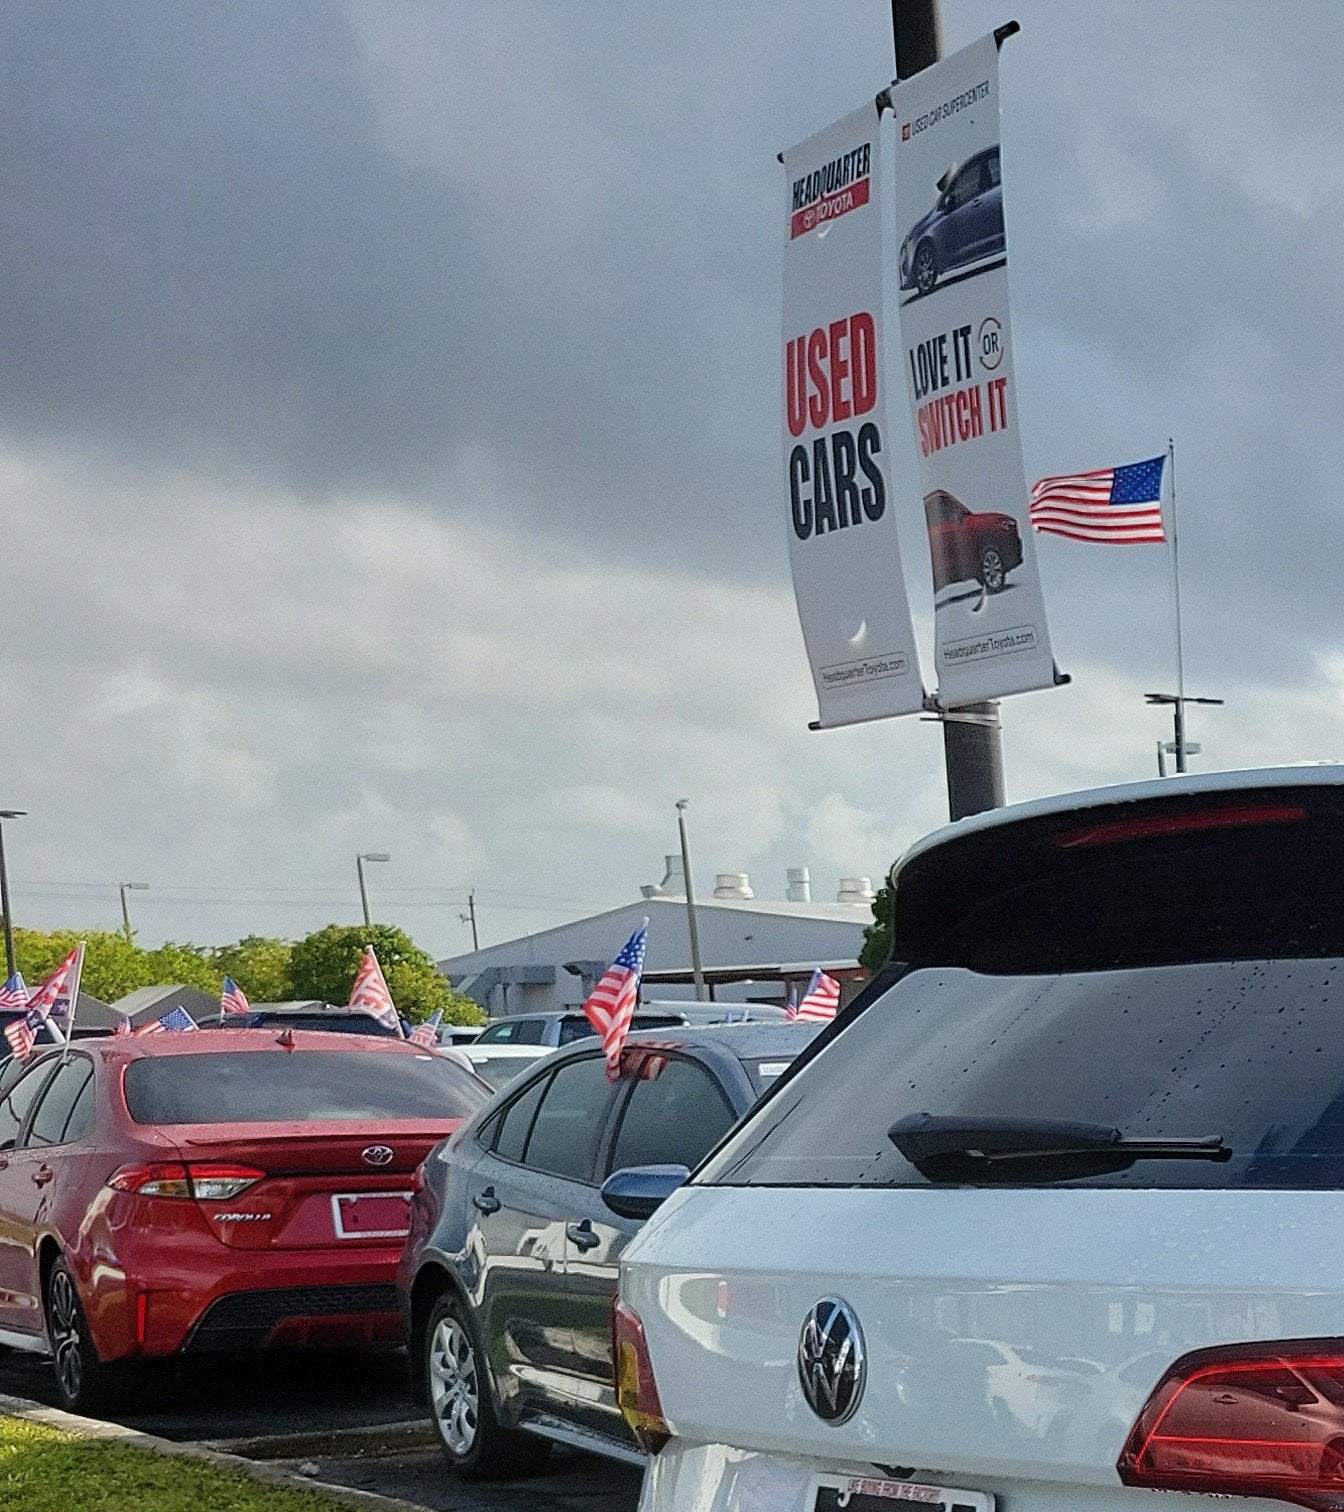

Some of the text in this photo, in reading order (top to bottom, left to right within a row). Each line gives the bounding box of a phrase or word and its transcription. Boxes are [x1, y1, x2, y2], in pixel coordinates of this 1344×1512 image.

[793, 142, 871, 214] HEADQUARTER
[816, 190, 854, 223] TOYOTA
[785, 312, 878, 437] USED
[909, 323, 1001, 401] LOVE IT OR
[917, 376, 1009, 458] SWITCH IT
[789, 422, 887, 541] CARS
[213, 1212, 272, 1222] COROLLA
